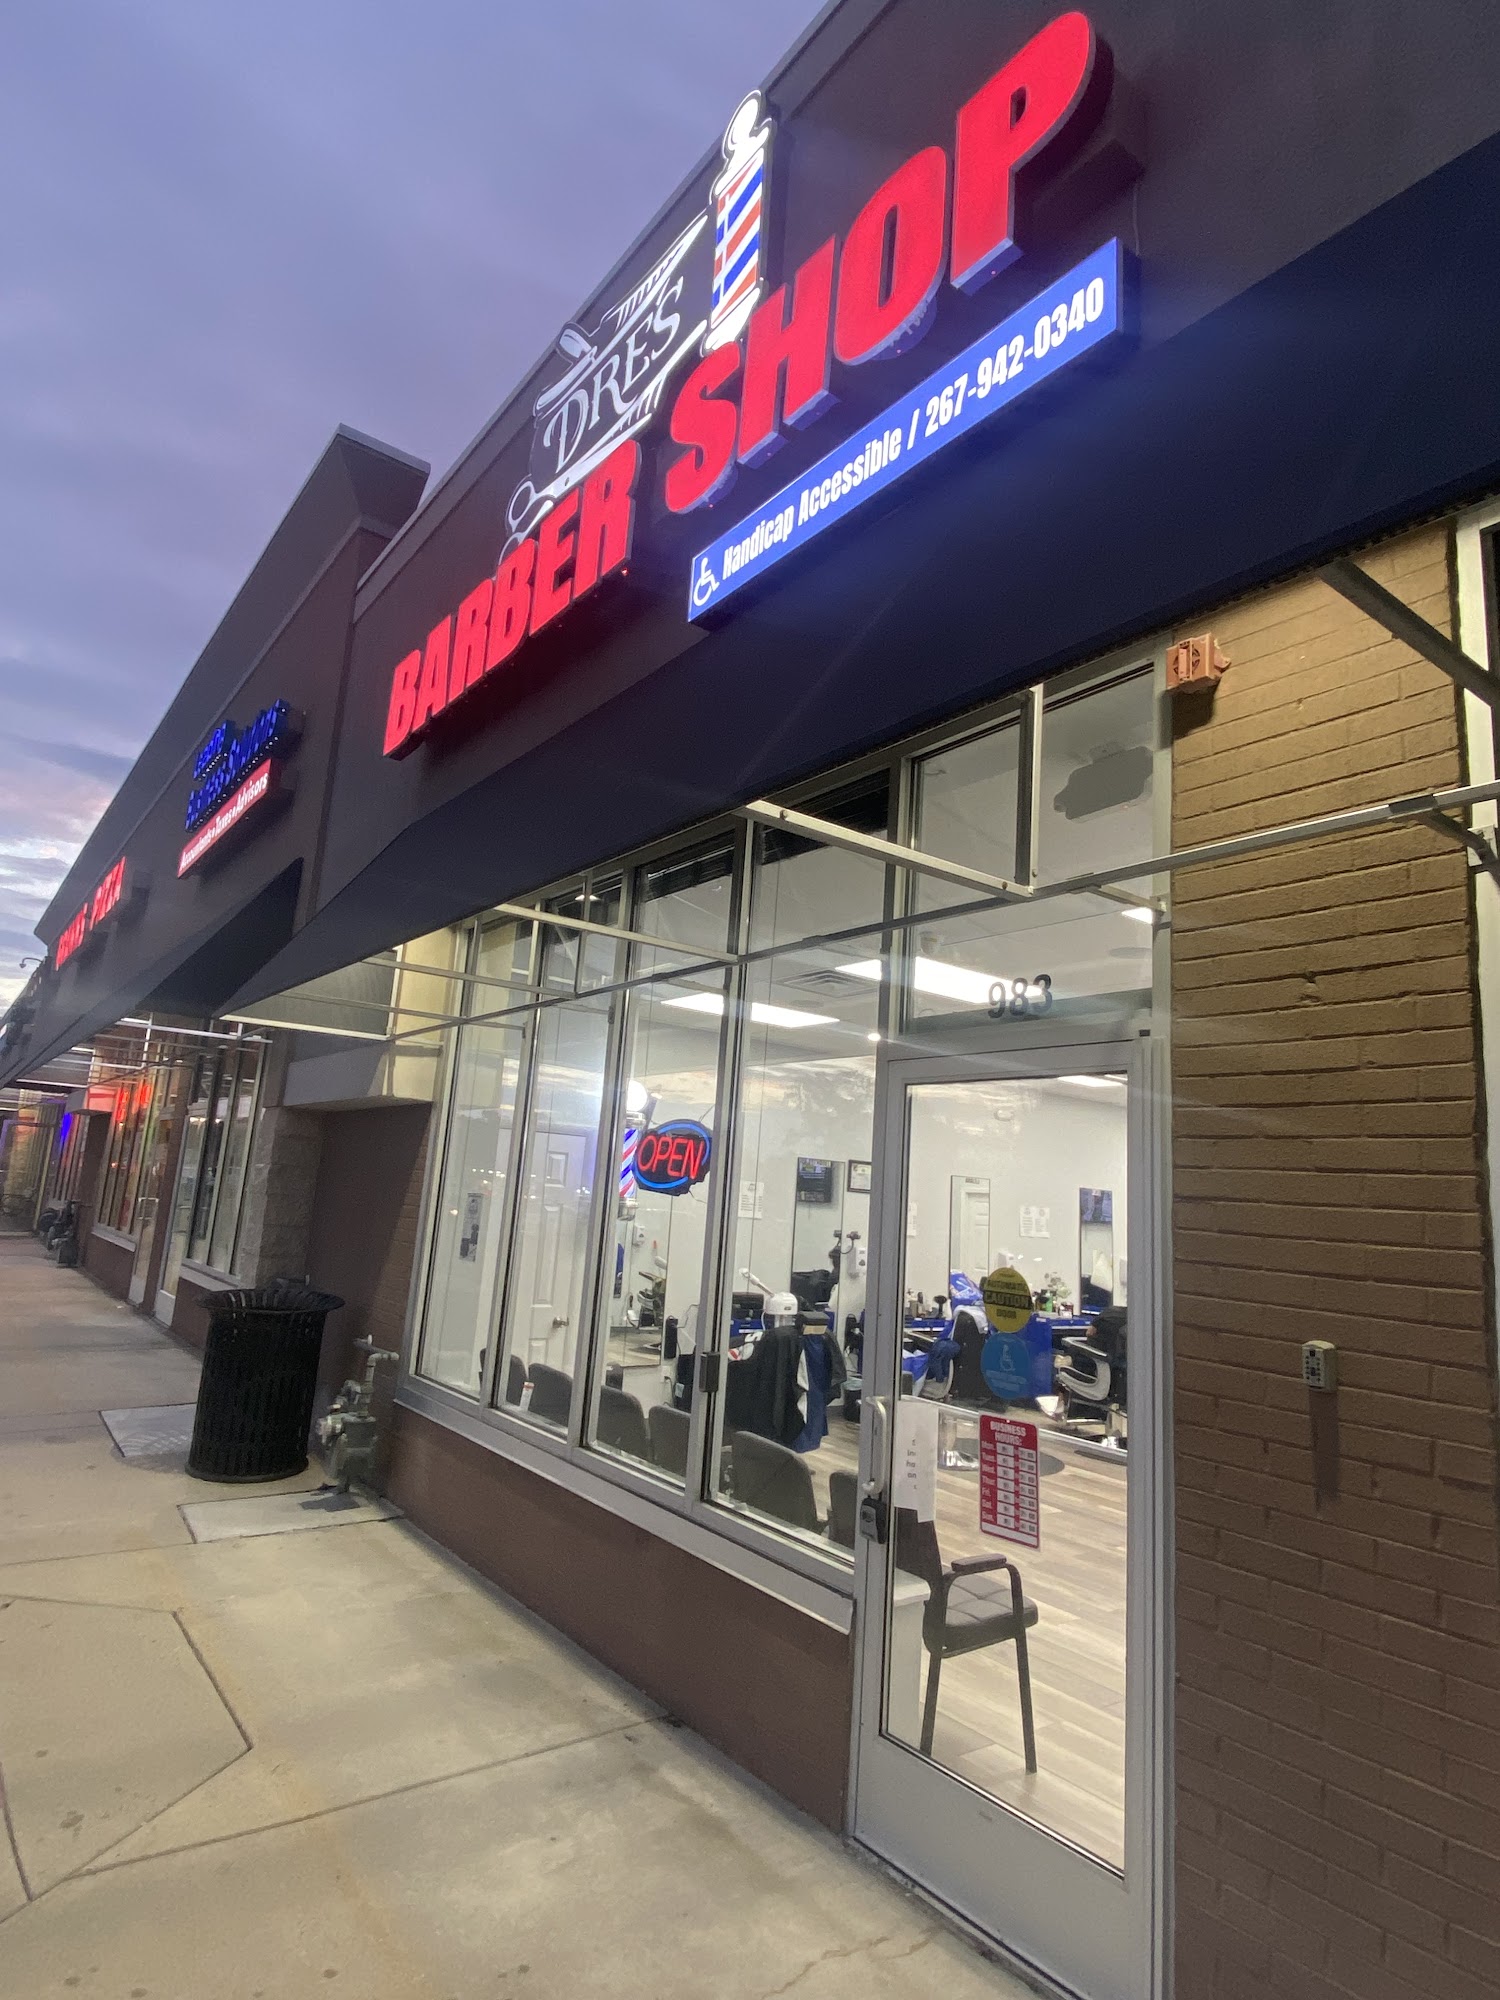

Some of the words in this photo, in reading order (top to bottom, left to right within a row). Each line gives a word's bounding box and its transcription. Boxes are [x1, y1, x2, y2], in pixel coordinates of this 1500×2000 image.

[383, 439, 638, 756] BARBER
[666, 11, 1092, 515] SHOP
[722, 505, 795, 580] Handicap
[798, 427, 902, 526] Accessible
[925, 277, 1104, 437] 267-942-0340
[987, 973, 1053, 1019] 983
[637, 1134, 704, 1180] OPEN
[990, 1421, 1027, 1437] BUSINESS
